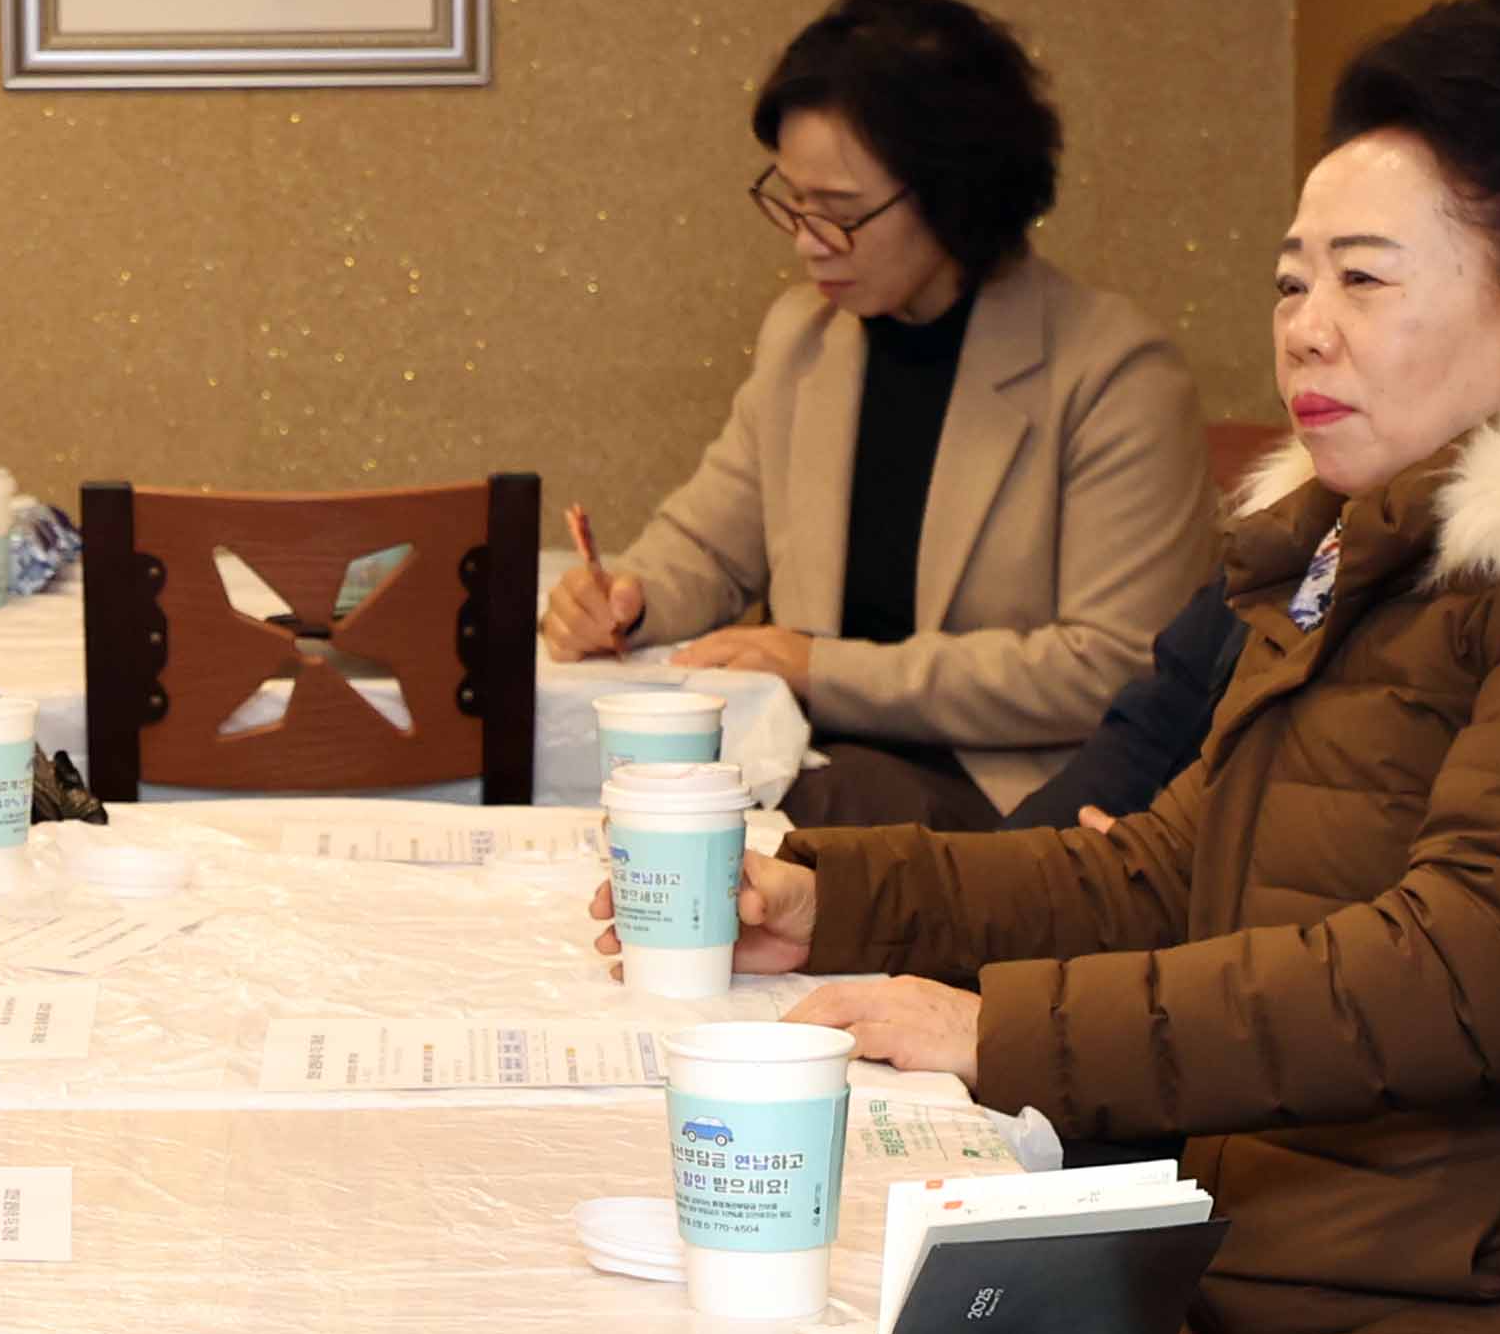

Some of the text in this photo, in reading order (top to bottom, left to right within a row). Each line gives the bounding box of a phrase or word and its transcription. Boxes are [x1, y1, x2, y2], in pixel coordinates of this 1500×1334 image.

[734, 1152, 804, 1172] 연납하고
[712, 1175, 789, 1195] 받으세요!
[967, 1287, 994, 1320] 2025
